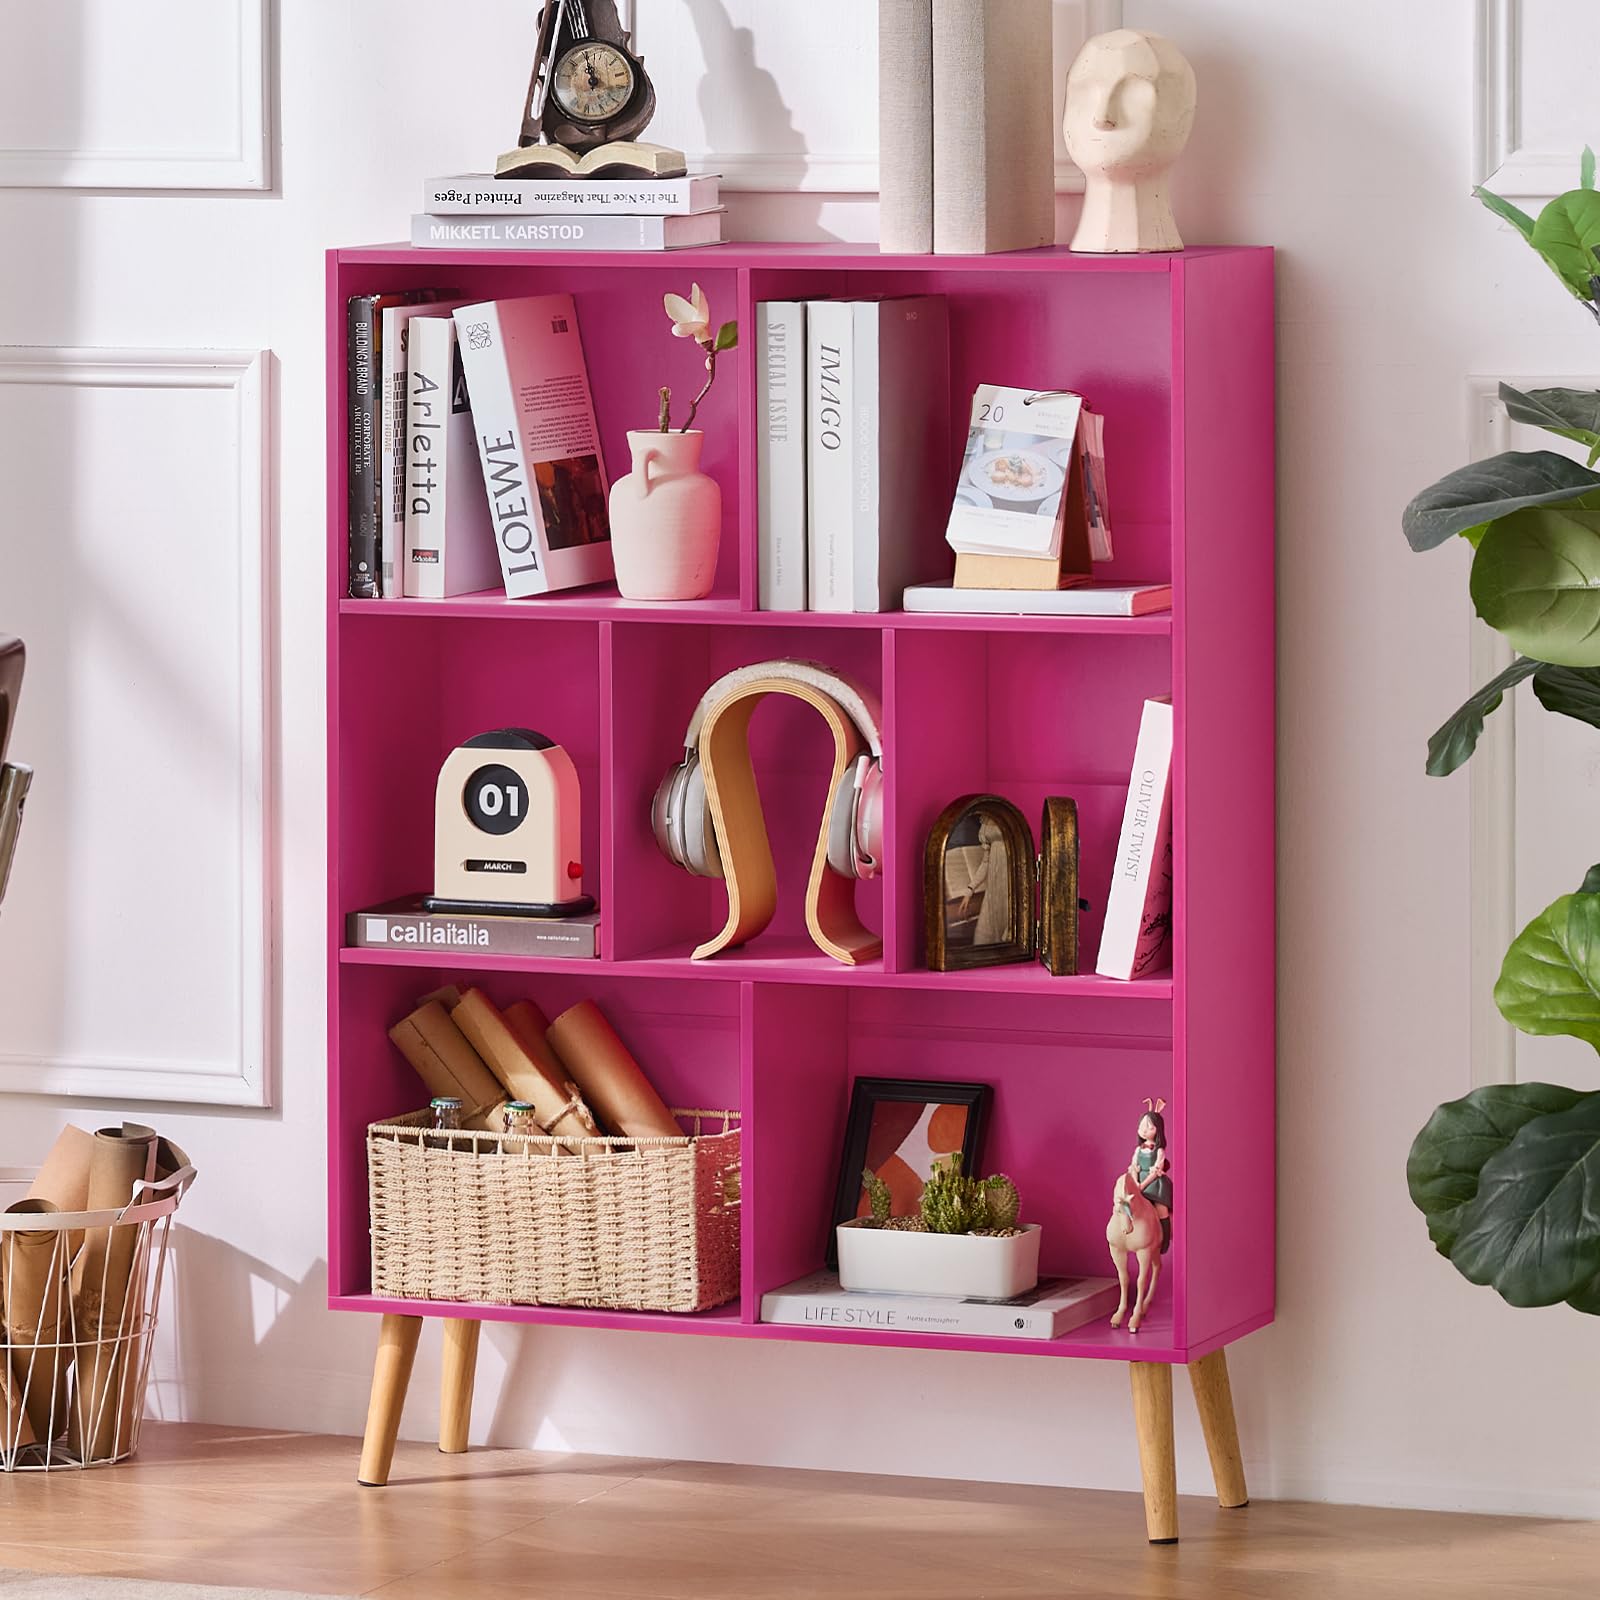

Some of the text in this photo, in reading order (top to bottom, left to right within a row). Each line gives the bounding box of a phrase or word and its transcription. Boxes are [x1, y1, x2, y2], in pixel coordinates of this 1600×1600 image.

[433, 189, 523, 205] Printed Pages
[534, 190, 584, 204] Magazine
[587, 193, 611, 204] That
[613, 193, 637, 204] Nice
[657, 193, 679, 204] The
[430, 225, 584, 240] MIKKETL KARSTOD
[767, 322, 788, 442] SPECIAL ISSUE
[820, 343, 842, 451] IMAGO
[979, 404, 1004, 423] 20
[354, 404, 362, 476] ARCHITECTURE
[363, 412, 371, 468] CORPORATE
[412, 371, 441, 515] Arletta
[483, 430, 539, 576] LOEWE
[478, 783, 519, 817] 01
[1124, 770, 1155, 882] OLIVER TWIST
[483, 861, 513, 871] MARCH
[390, 921, 490, 946] caliaitalia
[804, 1306, 897, 1325] LIFE STYLE
